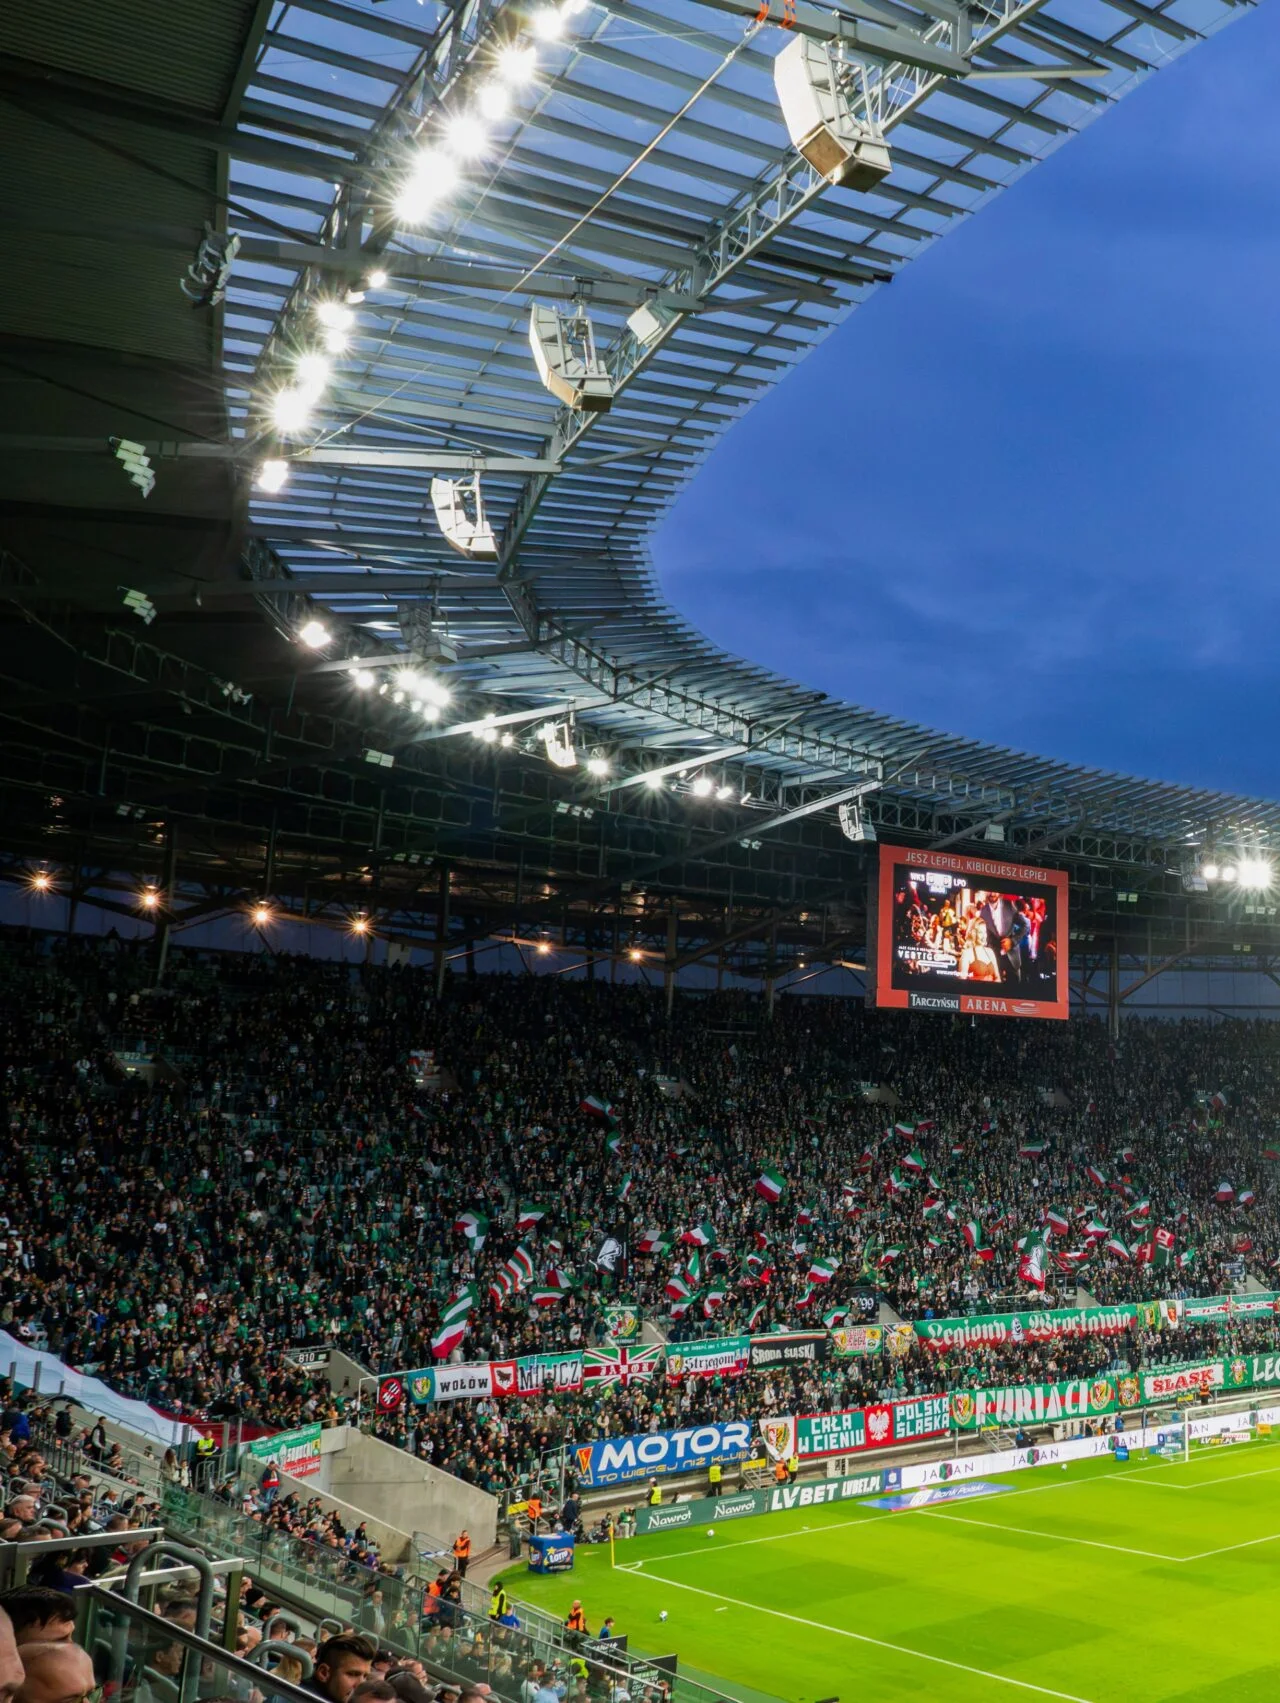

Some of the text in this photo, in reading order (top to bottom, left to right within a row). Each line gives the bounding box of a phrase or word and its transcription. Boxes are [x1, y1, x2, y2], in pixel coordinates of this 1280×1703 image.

[905, 852, 1047, 881] JESZ LEPIEJ, KIBICUJESZ LEPIEJ
[911, 993, 1008, 1013] TARCZYŃSKI ARENA
[928, 1318, 1007, 1349] Legiony
[299, 1352, 315, 1363] B10
[440, 1376, 488, 1393] WOŁÓW
[896, 1399, 951, 1422] POLSKA
[975, 1382, 1089, 1426] FURIACI
[597, 1423, 749, 1472] MOTOR
[798, 1428, 865, 1454] W CIENIU
[750, 1449, 758, 1460] 6
[597, 1474, 618, 1484] TO
[515, 1490, 524, 1502] 5
[771, 1483, 839, 1510] LVBET
[648, 1510, 693, 1530] Nawrot
[714, 1501, 756, 1520] Nawrot
